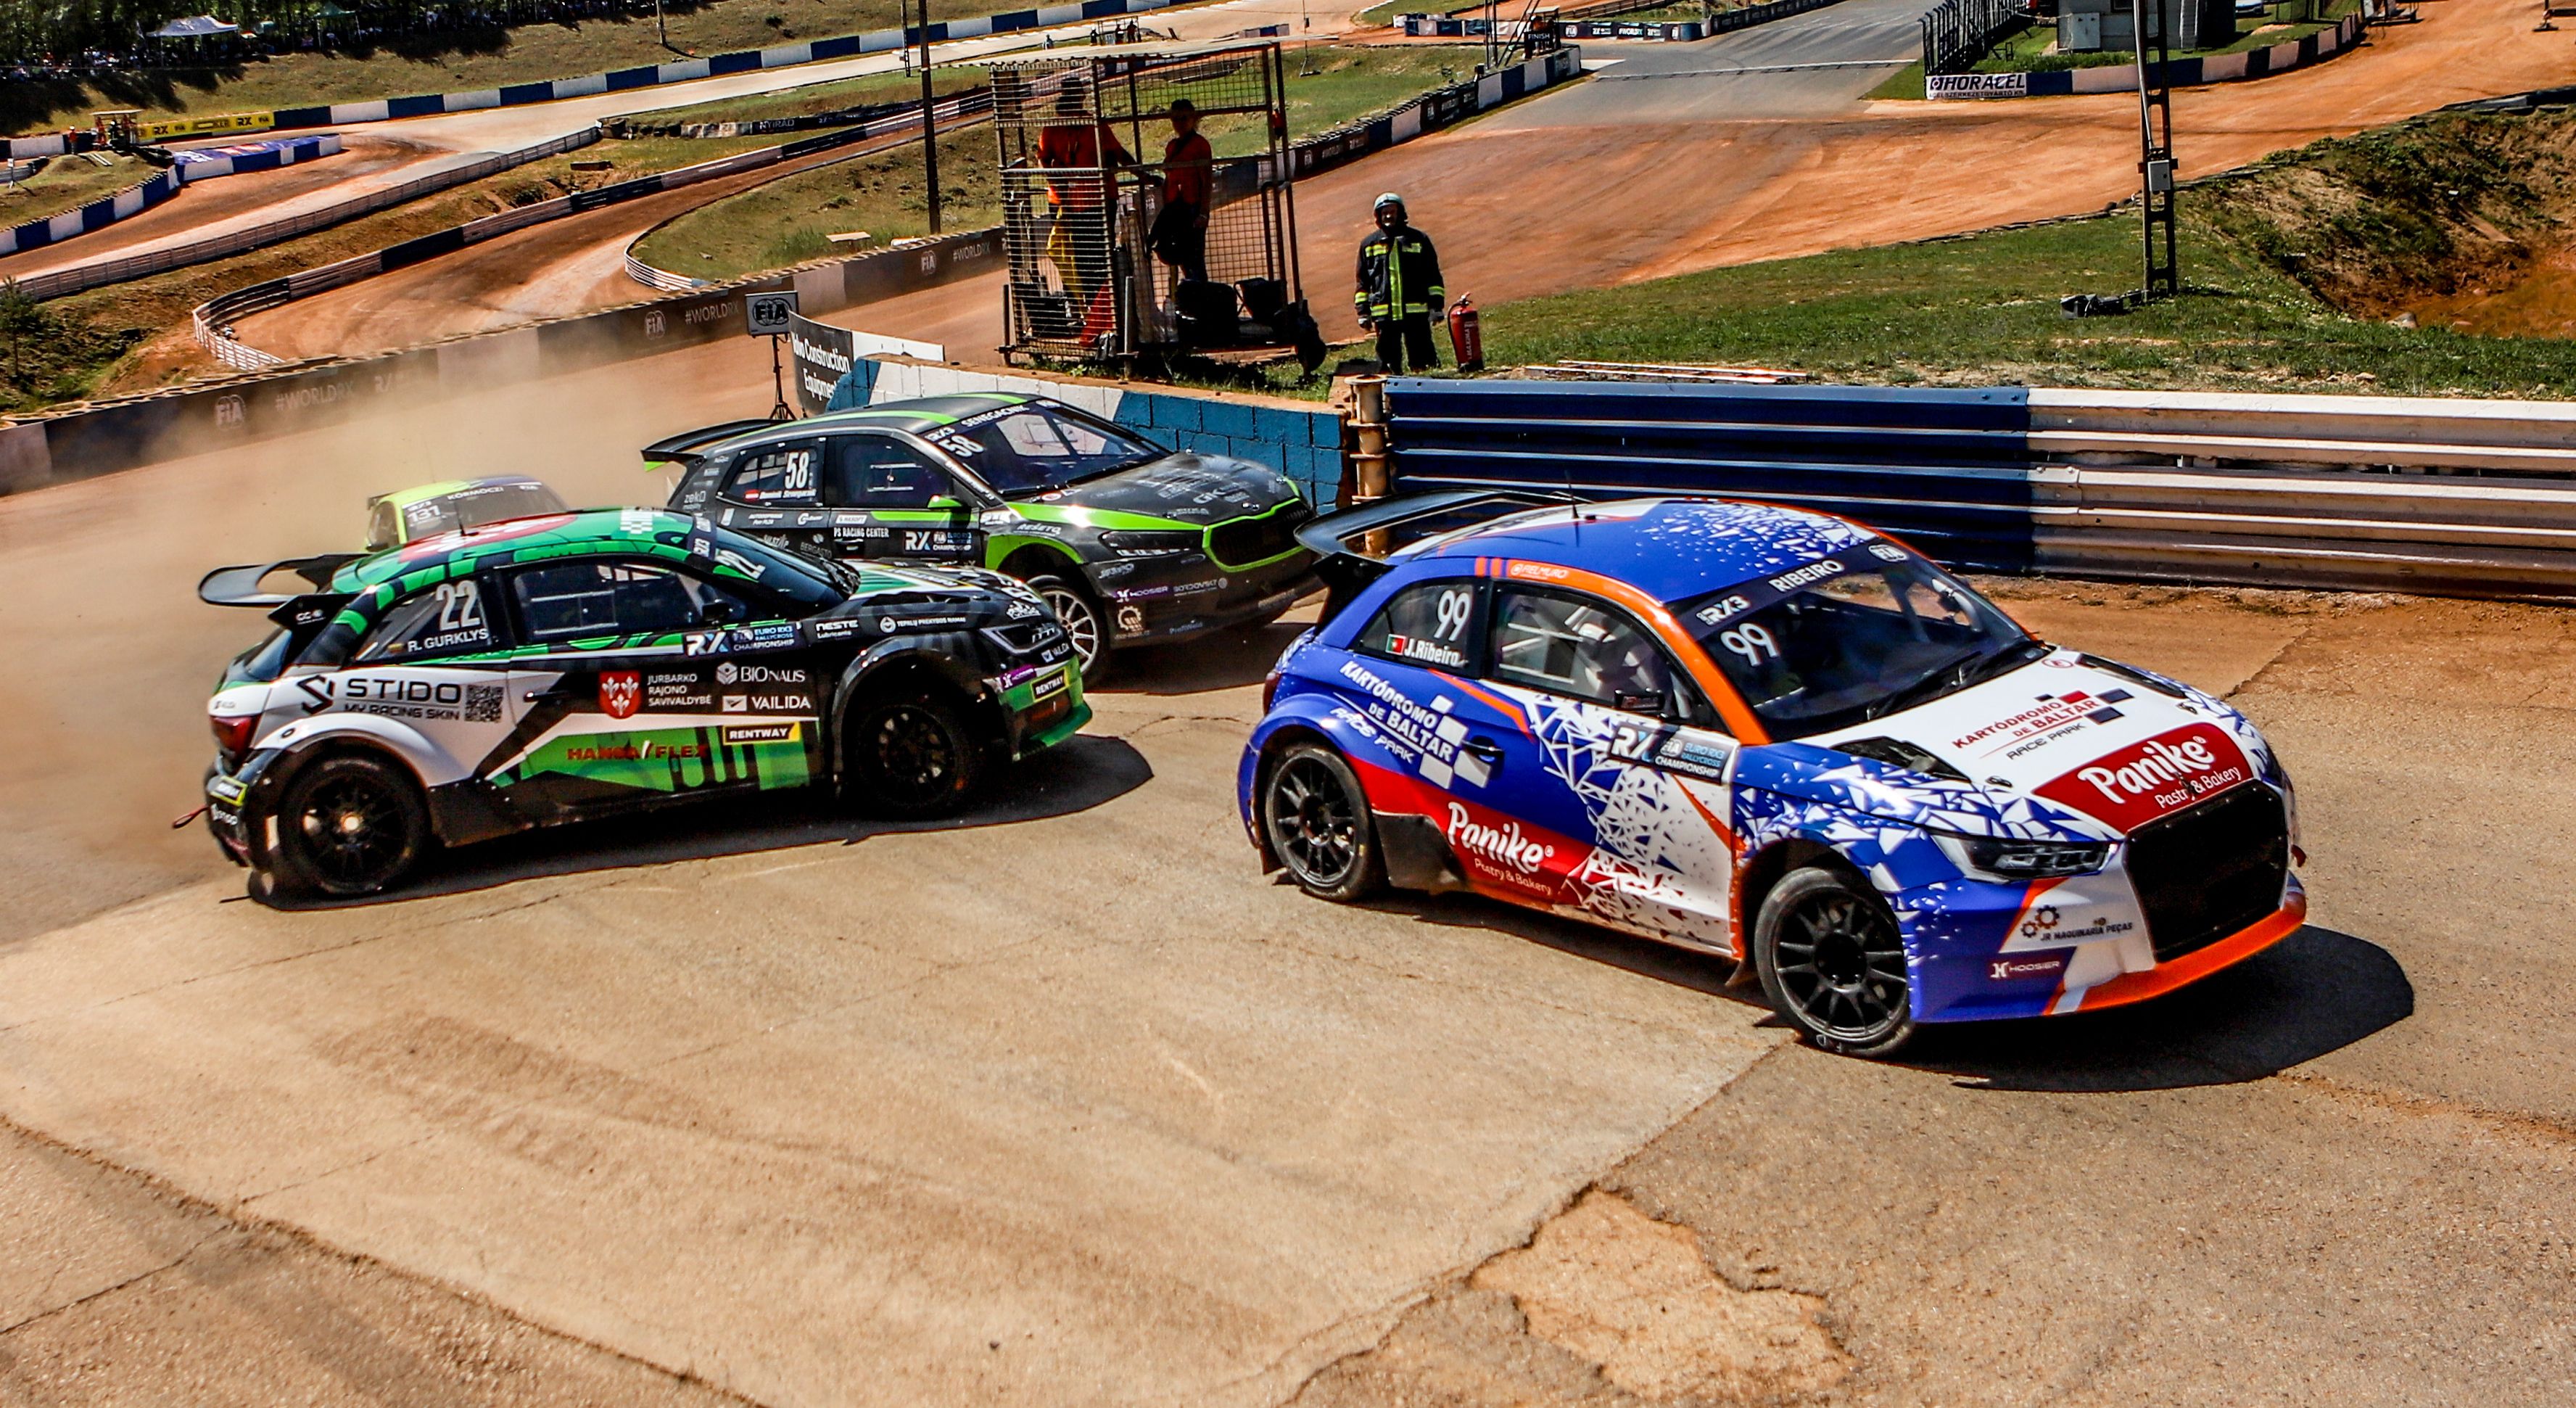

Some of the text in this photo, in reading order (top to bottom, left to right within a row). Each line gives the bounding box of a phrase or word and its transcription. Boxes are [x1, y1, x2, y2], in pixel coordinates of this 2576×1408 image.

[153, 125, 168, 136] RX
[237, 116, 252, 126] RX
[685, 300, 740, 326] #WORLDRX
[754, 301, 790, 323] FIA
[804, 337, 851, 374] Construction
[215, 398, 244, 427] FIA
[276, 381, 354, 412] #WORLDRX
[938, 435, 985, 458] 58
[784, 451, 809, 490] 58
[407, 505, 441, 522] 131
[834, 527, 889, 538] PS RACING CENTER
[906, 531, 930, 551] RX
[1768, 559, 1845, 592] RIBEIRO
[1129, 585, 1168, 597] HOOSIER
[436, 580, 481, 631] 22
[1434, 589, 1471, 642] 99
[816, 619, 859, 632] NESTE
[817, 630, 852, 639] Lubricants
[408, 627, 490, 652] R. GURKLYS
[686, 631, 728, 656] RX
[733, 639, 795, 651] CHAMPIONSHIP
[755, 633, 794, 641] RALLYCROSS
[1720, 622, 1779, 667] 99
[647, 672, 698, 686] JURBARKO
[648, 684, 688, 696] RAJONO
[1036, 675, 1064, 695] RENTWAY
[346, 678, 461, 704] STIDO
[648, 694, 712, 707] SAVIVALDYBĖ
[1339, 660, 1438, 729] KARTÓDROMO
[369, 704, 422, 719] RACING
[425, 708, 460, 720] SKIN
[751, 696, 812, 710] VAILIDA
[1952, 701, 2063, 749] KARTÓDROMO
[2012, 700, 2100, 738] DE BALTAR
[729, 728, 788, 740] RENTWAY
[1330, 707, 1415, 764] RACE PARK
[1368, 702, 1454, 762] DE BALTAR
[2005, 722, 2087, 760] RACE PARK
[1611, 727, 1656, 762] RX
[1685, 742, 1708, 755] EURO
[1654, 755, 1720, 777] CHAMPIONSHIP
[1681, 752, 1722, 767] RALLYCROSS
[2190, 779, 2205, 794] &
[2200, 766, 2241, 790] Bakery
[1474, 857, 1553, 896] Pastry & Bakery
[2041, 922, 2133, 942] JR MAQUINARIA PEÇAS
[2009, 960, 2060, 972] HOOSIER
